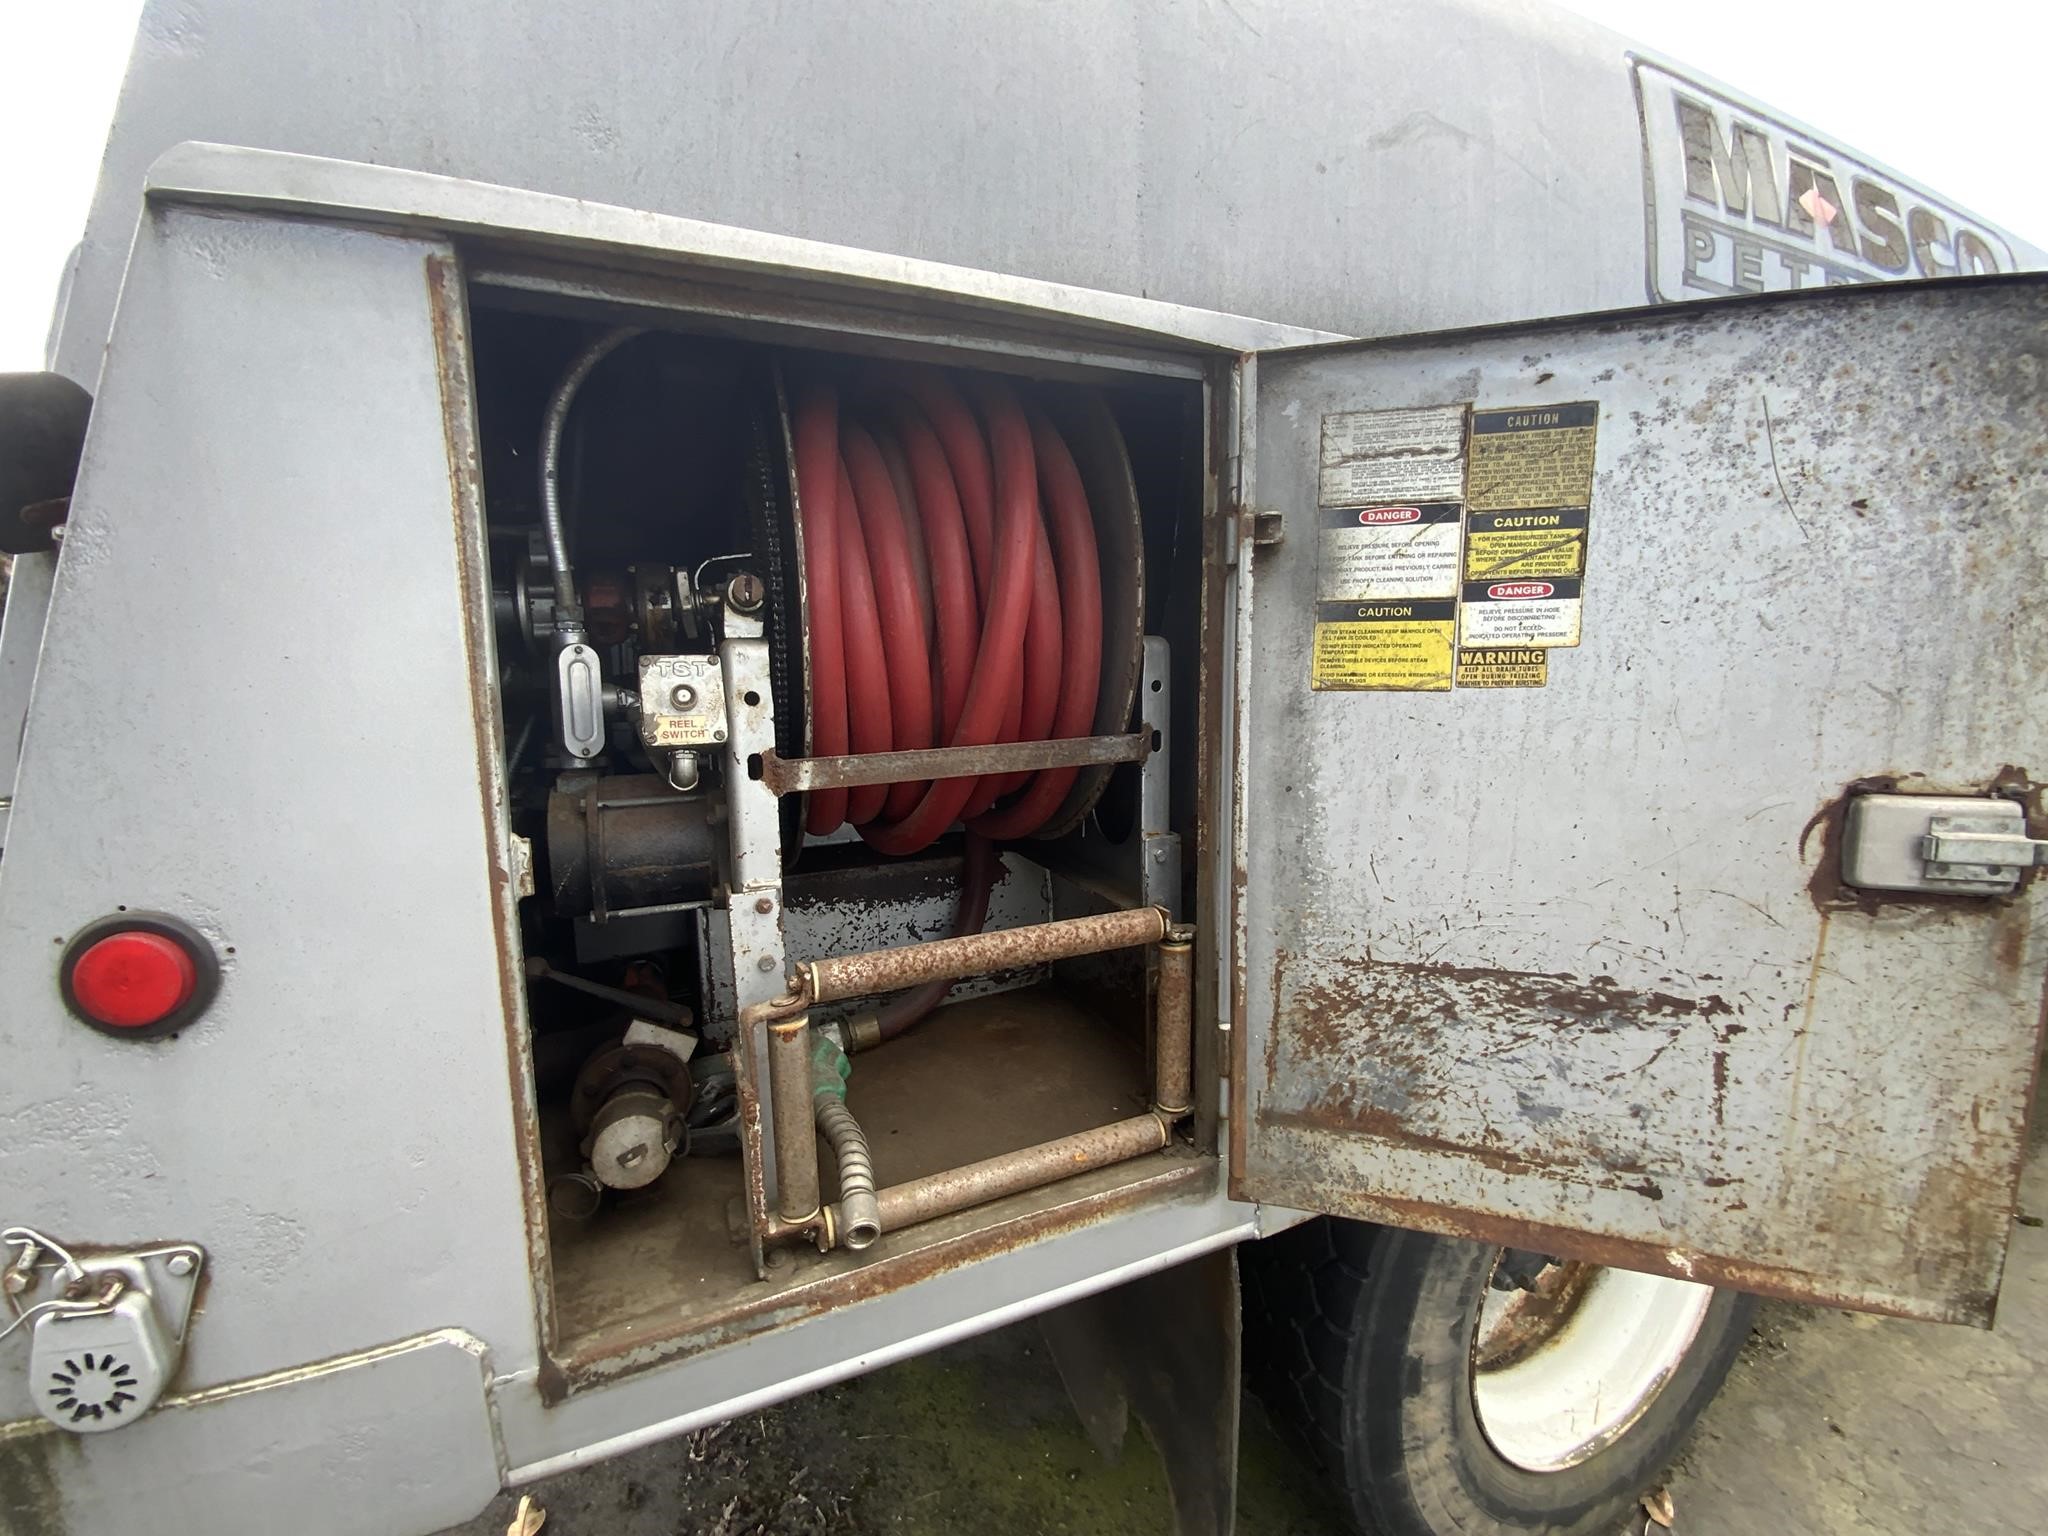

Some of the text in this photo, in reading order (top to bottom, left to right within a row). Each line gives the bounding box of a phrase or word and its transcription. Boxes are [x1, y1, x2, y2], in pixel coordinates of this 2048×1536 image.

[1672, 90, 1999, 279] MASCO
[1507, 414, 1560, 427] CAUTION
[1368, 511, 1412, 520] DANGER
[1494, 516, 1560, 528] CAUTION
[1497, 586, 1544, 596] DANGER
[1358, 607, 1412, 617] CAUTION
[1460, 651, 1544, 664] WARNING
[669, 720, 697, 728] REEL
[662, 730, 705, 740] SWITCH
